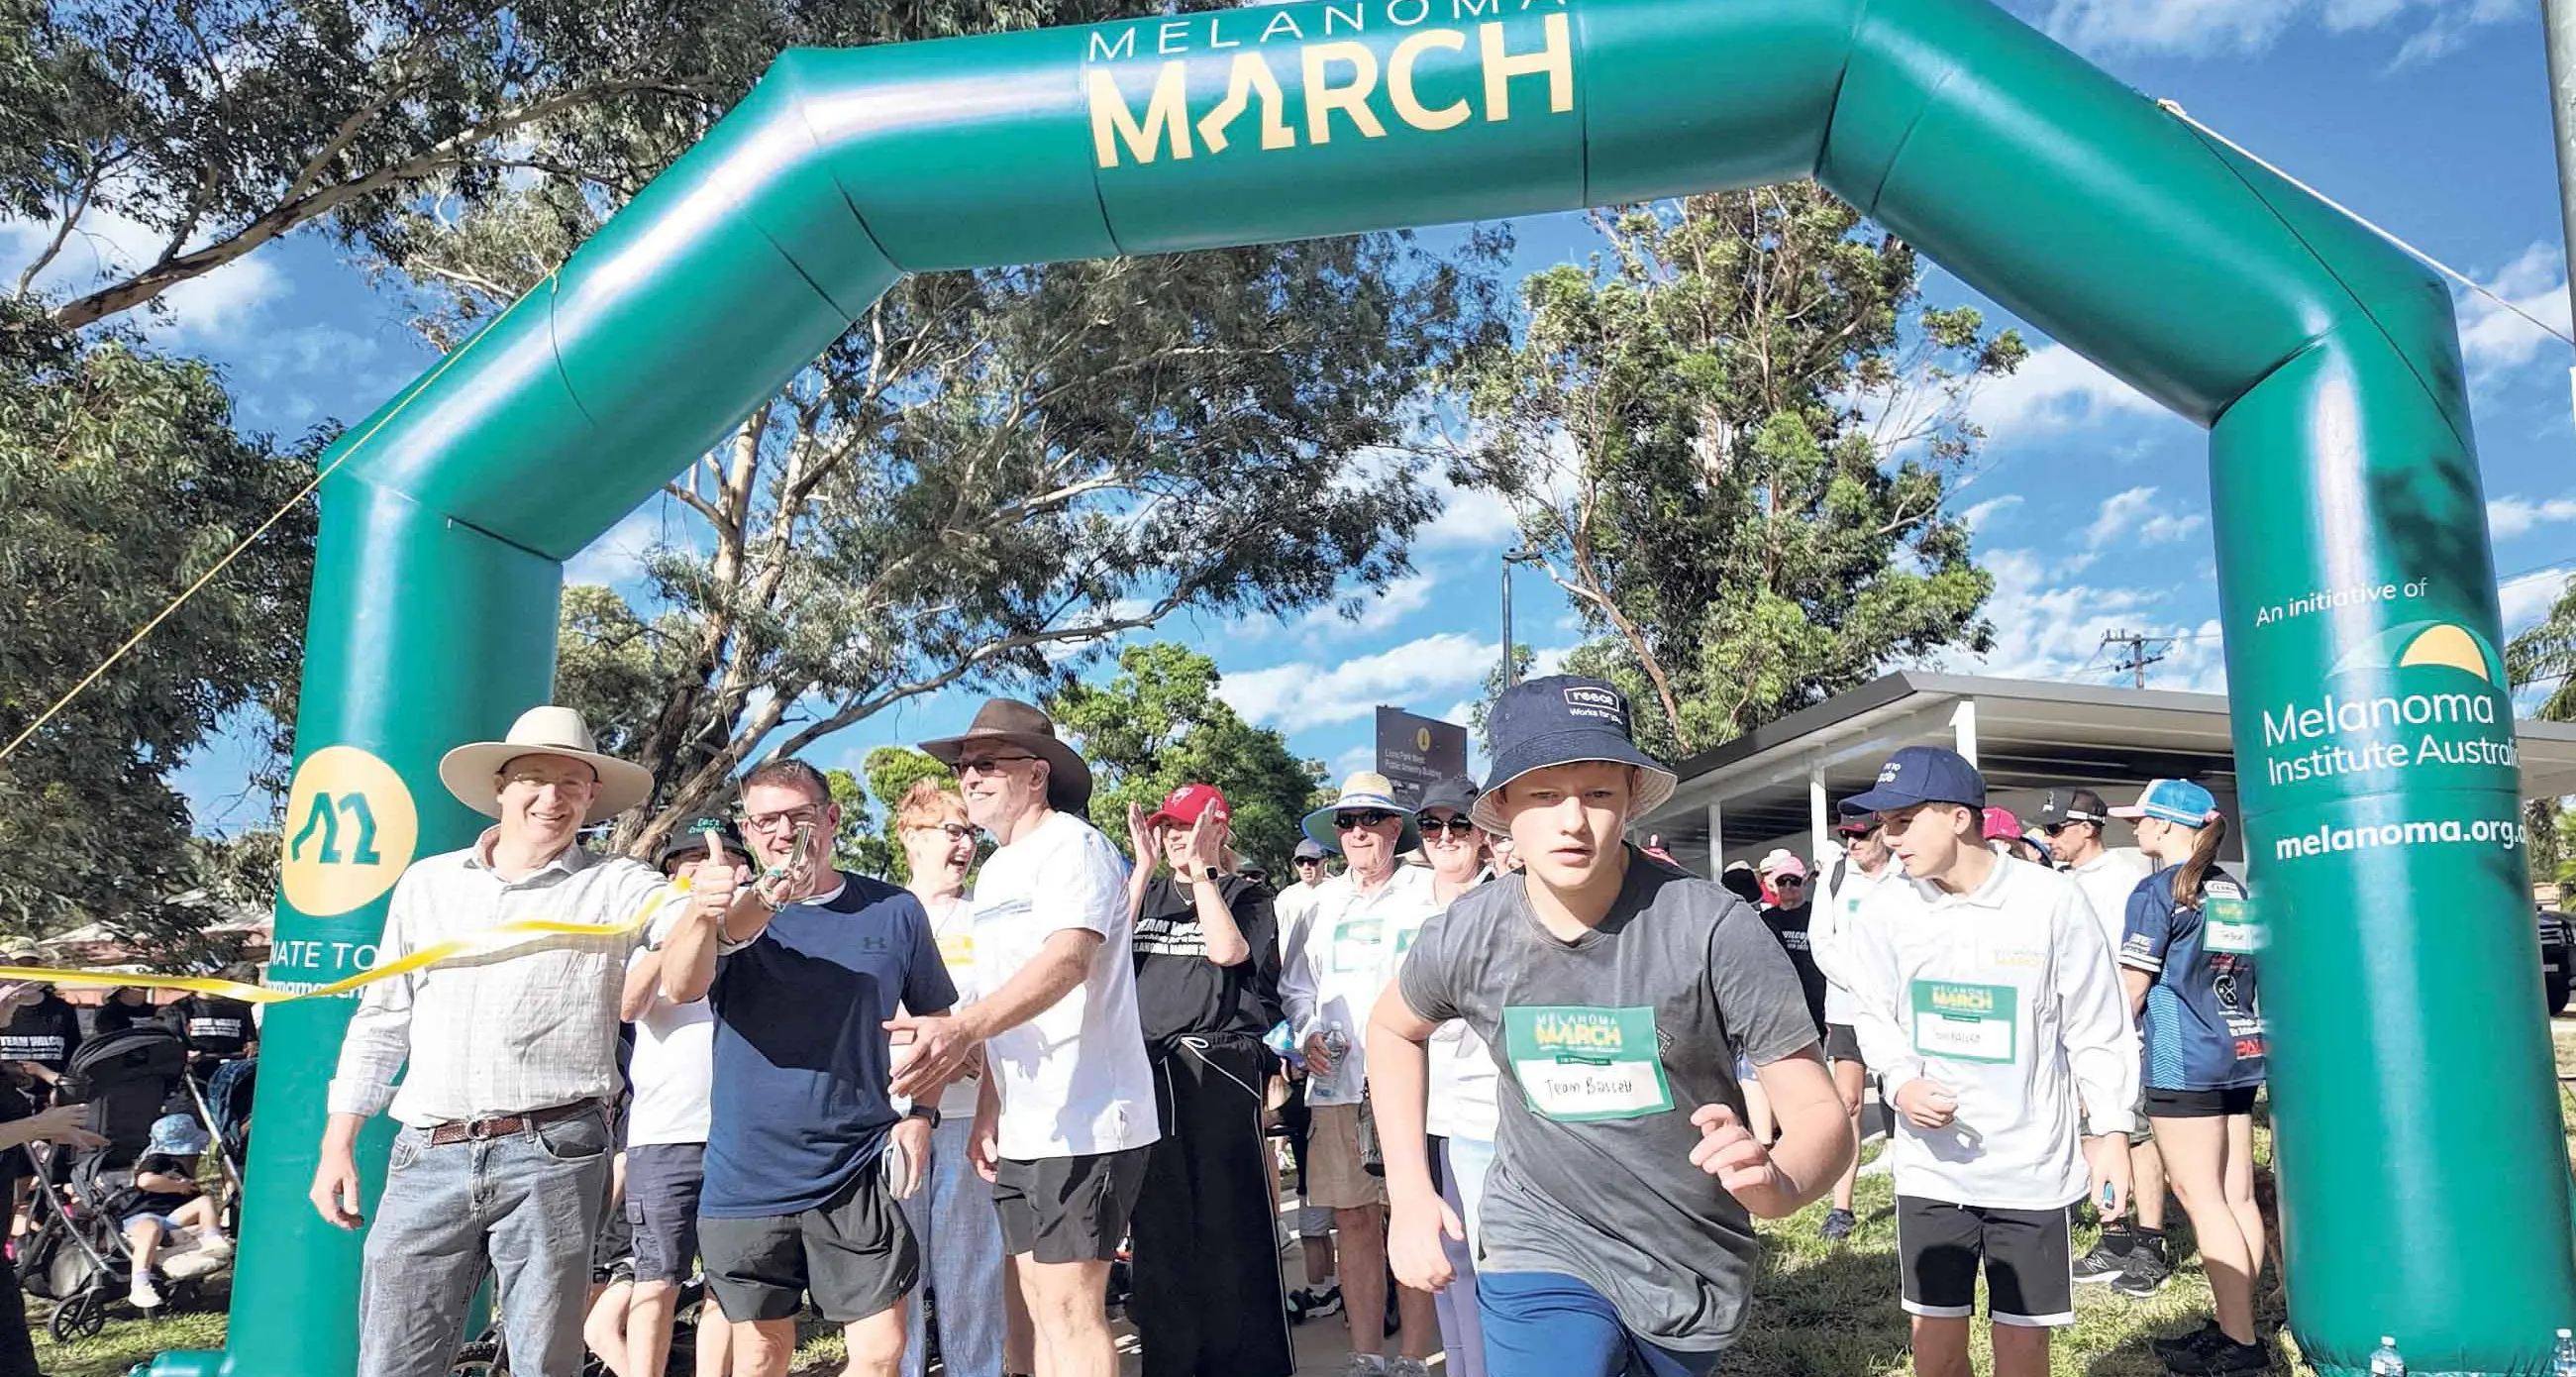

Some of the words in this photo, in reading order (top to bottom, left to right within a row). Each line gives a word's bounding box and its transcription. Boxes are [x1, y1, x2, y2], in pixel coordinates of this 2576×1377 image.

[1089, 12, 1573, 168] MARCH
[2256, 606, 2283, 627] An
[2290, 583, 2397, 617] initiative
[2404, 578, 2428, 597] of
[2263, 693, 2494, 747] Melanoma
[2268, 745, 2410, 786] Institute
[1535, 1022, 1623, 1047] MARCH
